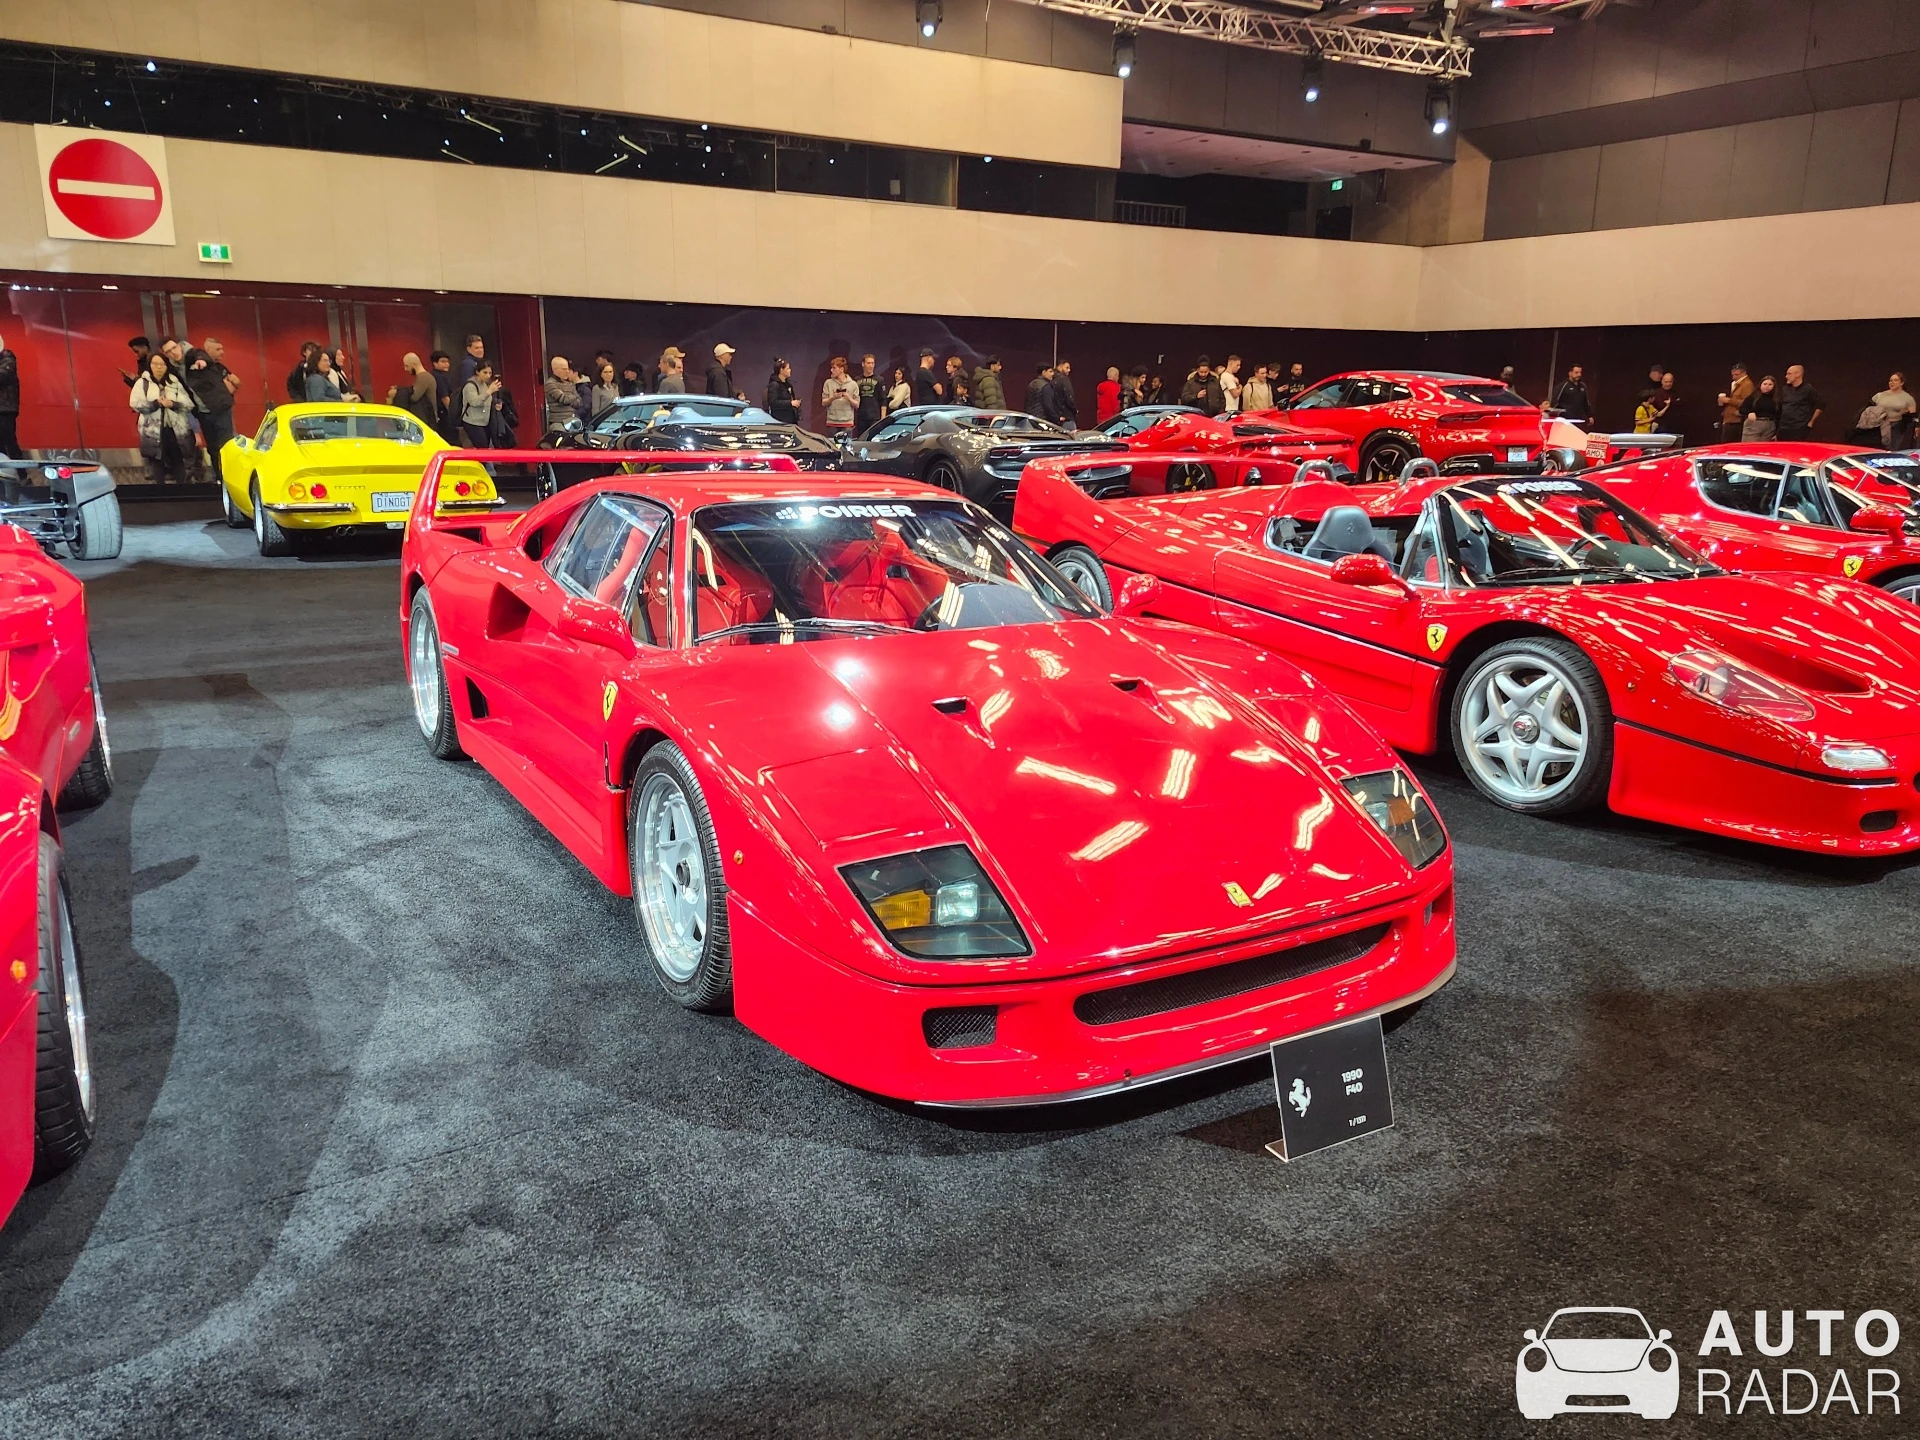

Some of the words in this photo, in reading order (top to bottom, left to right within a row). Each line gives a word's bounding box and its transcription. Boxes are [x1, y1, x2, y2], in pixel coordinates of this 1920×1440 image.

[798, 505, 917, 520] POIRIER
[1341, 1068, 1364, 1083] 1990
[1345, 1082, 1364, 1096] F40
